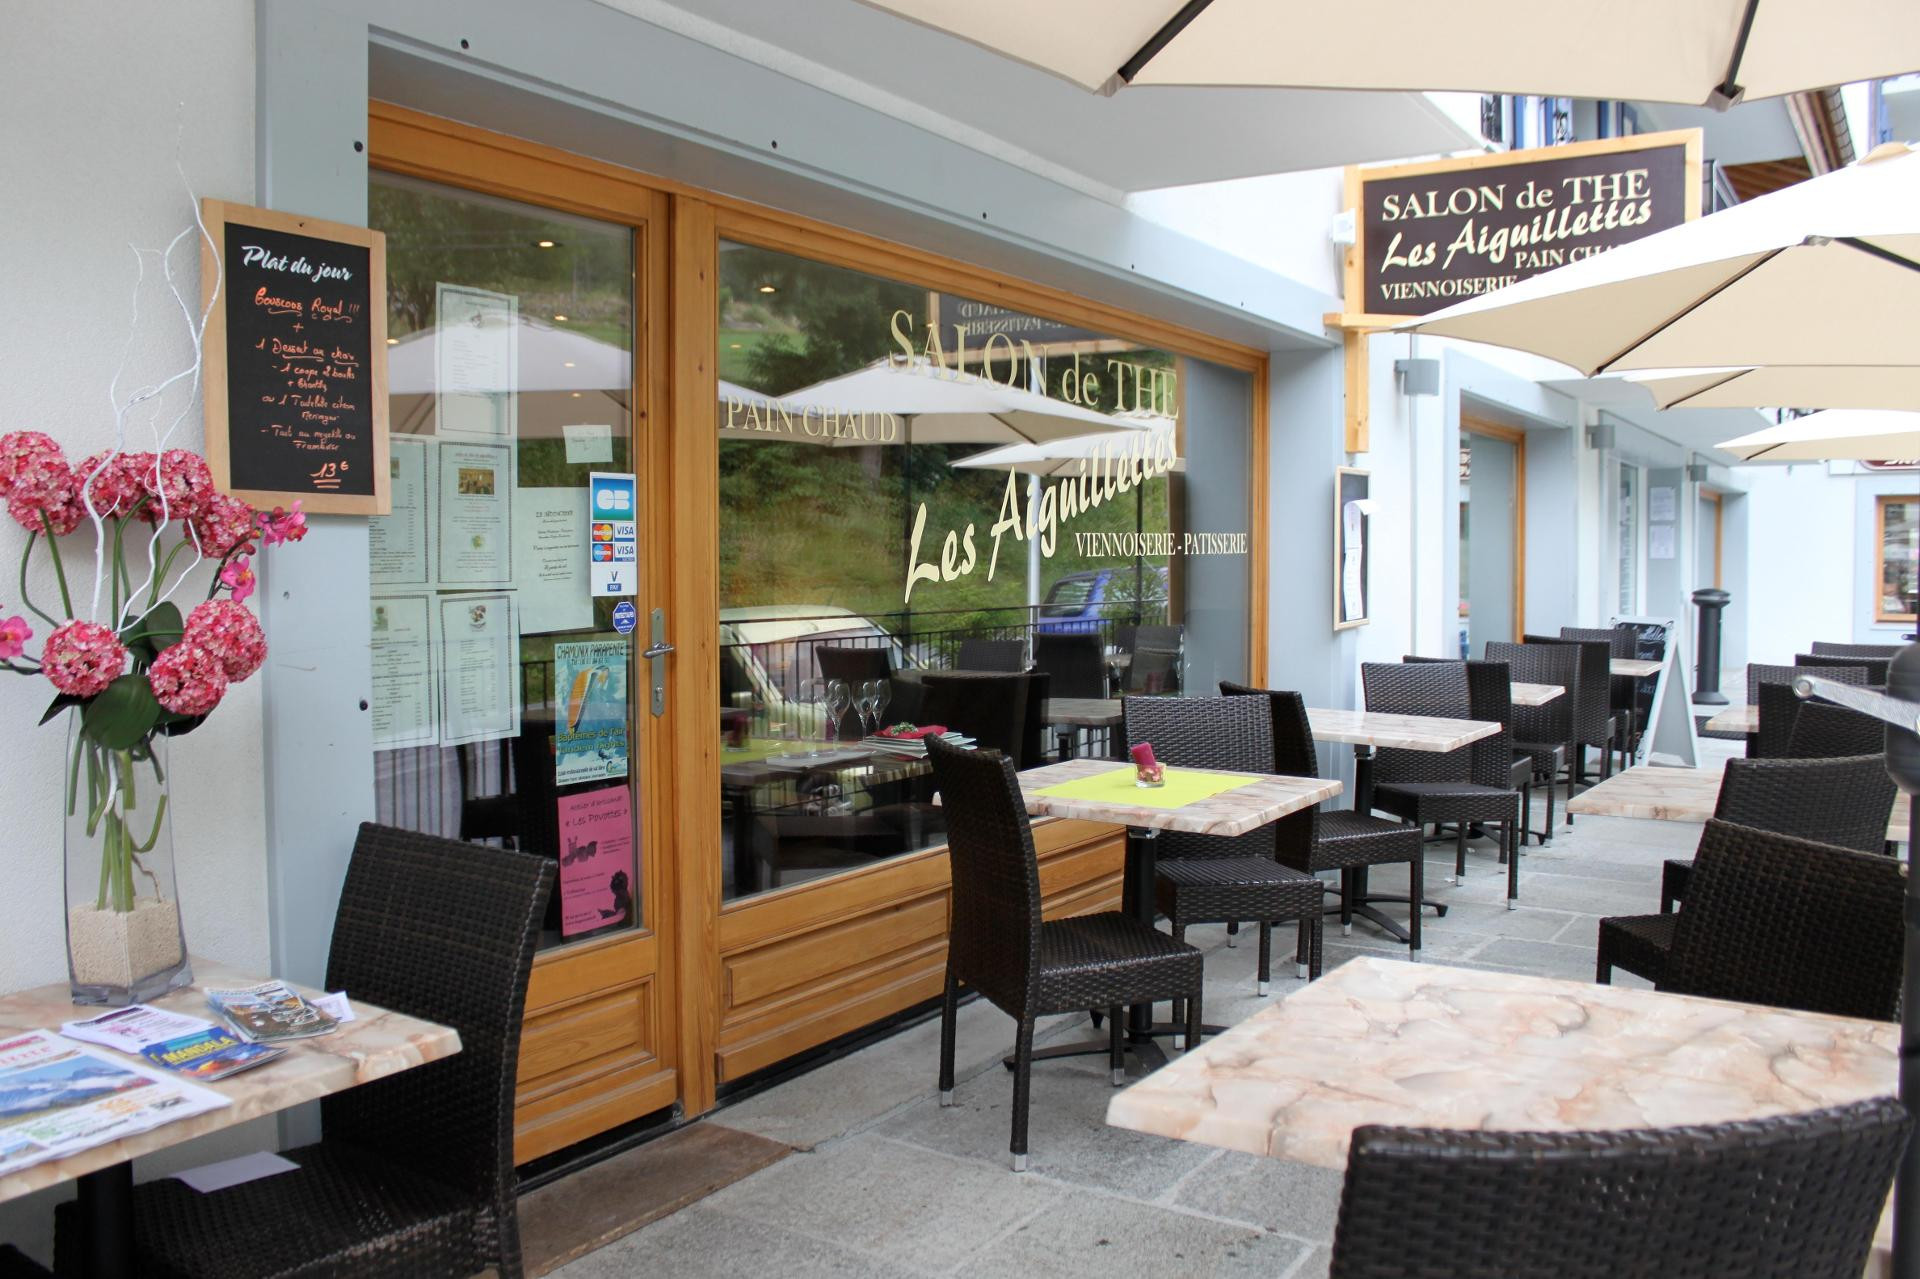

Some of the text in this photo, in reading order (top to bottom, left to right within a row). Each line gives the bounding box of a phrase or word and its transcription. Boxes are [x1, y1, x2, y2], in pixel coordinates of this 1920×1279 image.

[1382, 168, 1650, 222] SALON de THE
[1381, 199, 1651, 273] Les Aiguillettes
[241, 245, 352, 282] Plat du jour
[1515, 249, 1564, 269] PAIN
[312, 297, 342, 320] Royal
[889, 310, 1178, 420] SALON de THE
[726, 395, 897, 442] PAIN CHAUD
[310, 462, 337, 478] 13
[617, 526, 634, 535] VISA
[905, 427, 1177, 604] Les Aiguillettes
[617, 546, 634, 555] VISA
[1075, 532, 1176, 557] VIENNOISERIE
[1184, 533, 1247, 555] PATISSERIE
